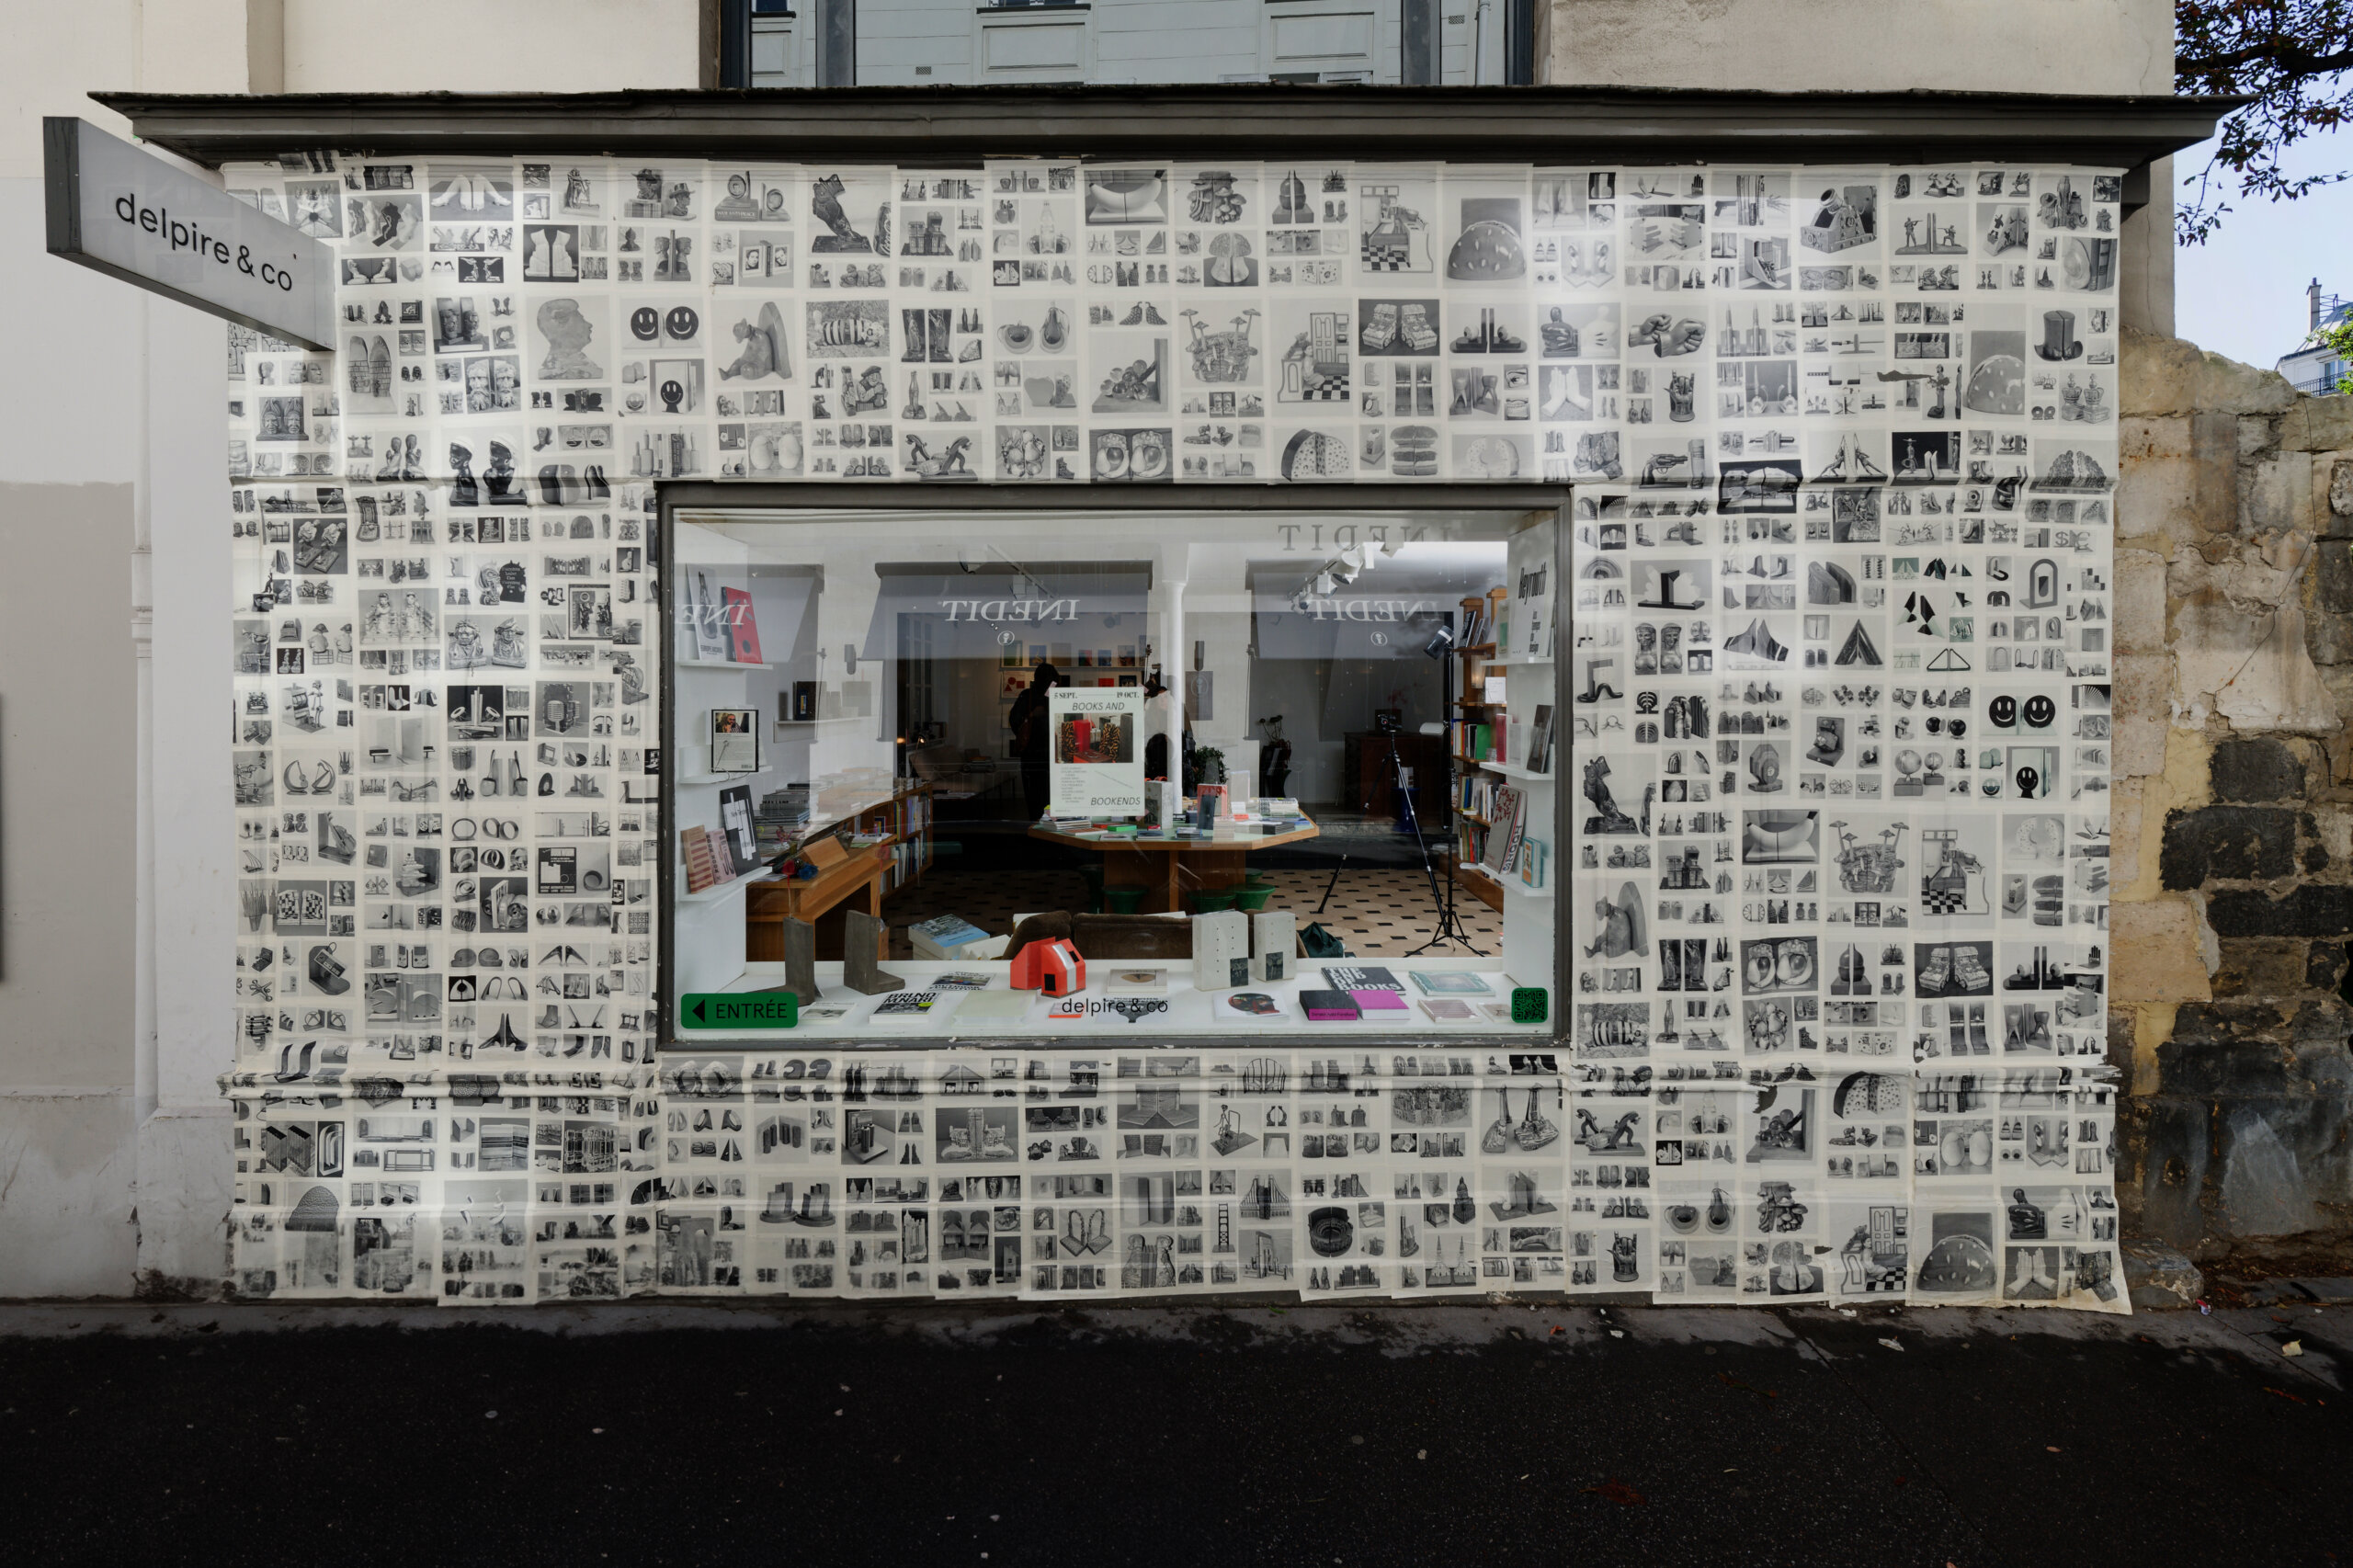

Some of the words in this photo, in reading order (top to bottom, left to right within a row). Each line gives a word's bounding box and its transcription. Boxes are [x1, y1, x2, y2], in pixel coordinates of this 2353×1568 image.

[115, 192, 231, 266] delpire
[237, 244, 256, 278] &
[261, 262, 293, 292] co
[1518, 562, 1547, 606] Beyrouth
[1072, 702, 1103, 711] BOOKS
[1105, 702, 1125, 710] AND
[1090, 797, 1141, 806] BOOKENDS
[715, 999, 788, 1019] ENTRÉE
[1062, 997, 1126, 1017] delpire
[1130, 998, 1142, 1013] &
[1146, 1000, 1168, 1013] co
